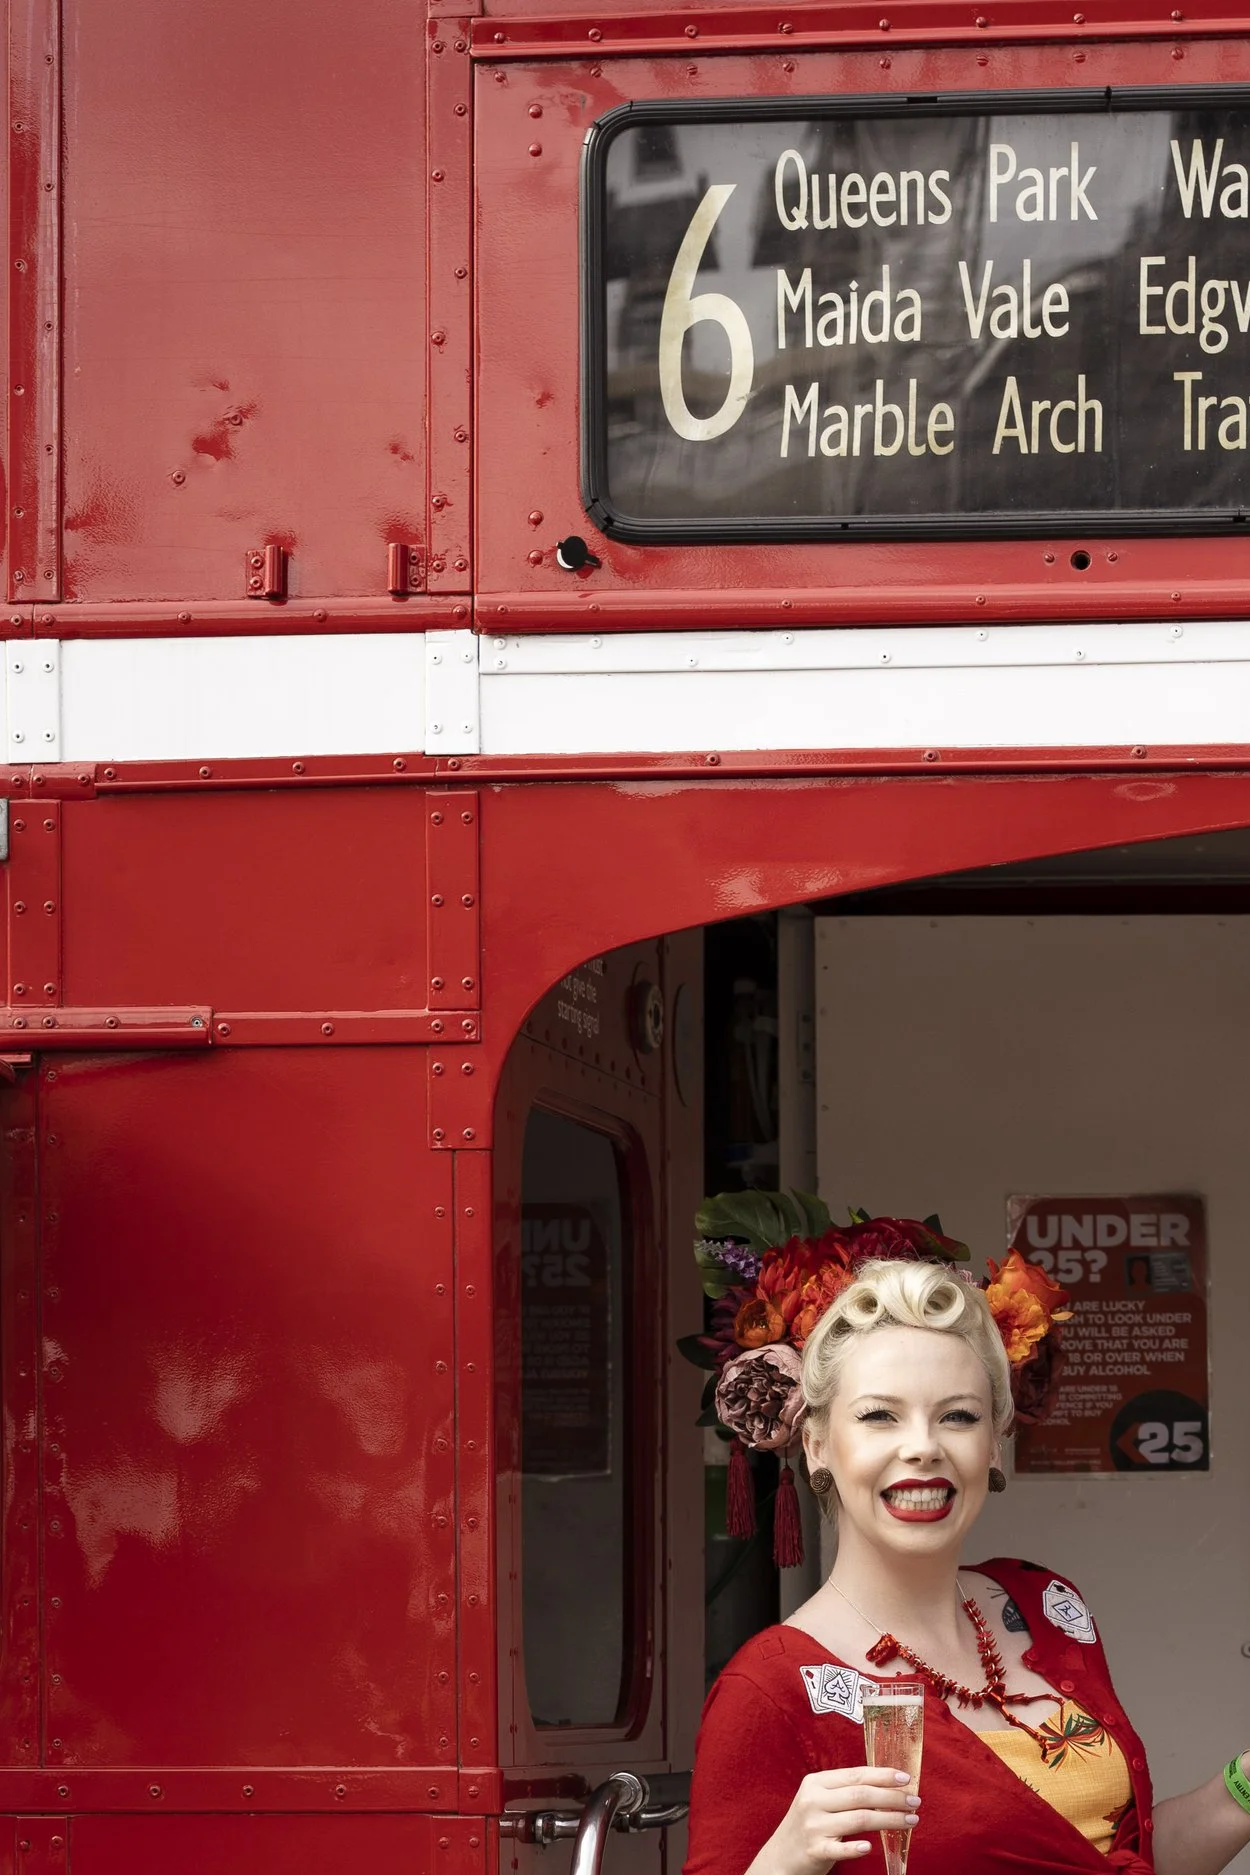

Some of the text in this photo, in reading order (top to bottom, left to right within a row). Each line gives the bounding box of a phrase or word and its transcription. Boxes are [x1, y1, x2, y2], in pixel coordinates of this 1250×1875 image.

[775, 149, 953, 230] Queens
[988, 141, 1099, 224] Park
[659, 183, 754, 442] 6
[778, 264, 922, 349] Maida
[959, 259, 1070, 340] Vale
[780, 379, 955, 459] Marble
[992, 375, 1103, 455] Arch
[572, 972, 586, 1001] give
[586, 977, 597, 1003] the
[557, 999, 600, 1038] starting signal
[1026, 1214, 1191, 1248] UNDER
[1026, 1249, 1108, 1283] 25?
[1073, 1301, 1099, 1311] ARE
[1102, 1300, 1146, 1311] LUCKY
[1087, 1314, 1105, 1324] TO
[1108, 1314, 1143, 1324] LOOK
[1147, 1313, 1192, 1323] UNDER
[1077, 1327, 1109, 1337] WILL
[1112, 1327, 1129, 1337] BE
[1132, 1326, 1176, 1336] ASKED
[1096, 1339, 1128, 1350] THAT
[1133, 1339, 1160, 1349] YOU
[1162, 1338, 1189, 1349] ARE
[1068, 1351, 1185, 1363] 18 OR OVER WHEN
[1089, 1365, 1151, 1376] ALCOHOL
[1138, 1421, 1204, 1464] 25
[1233, 1780, 1250, 1800] ENTRY
